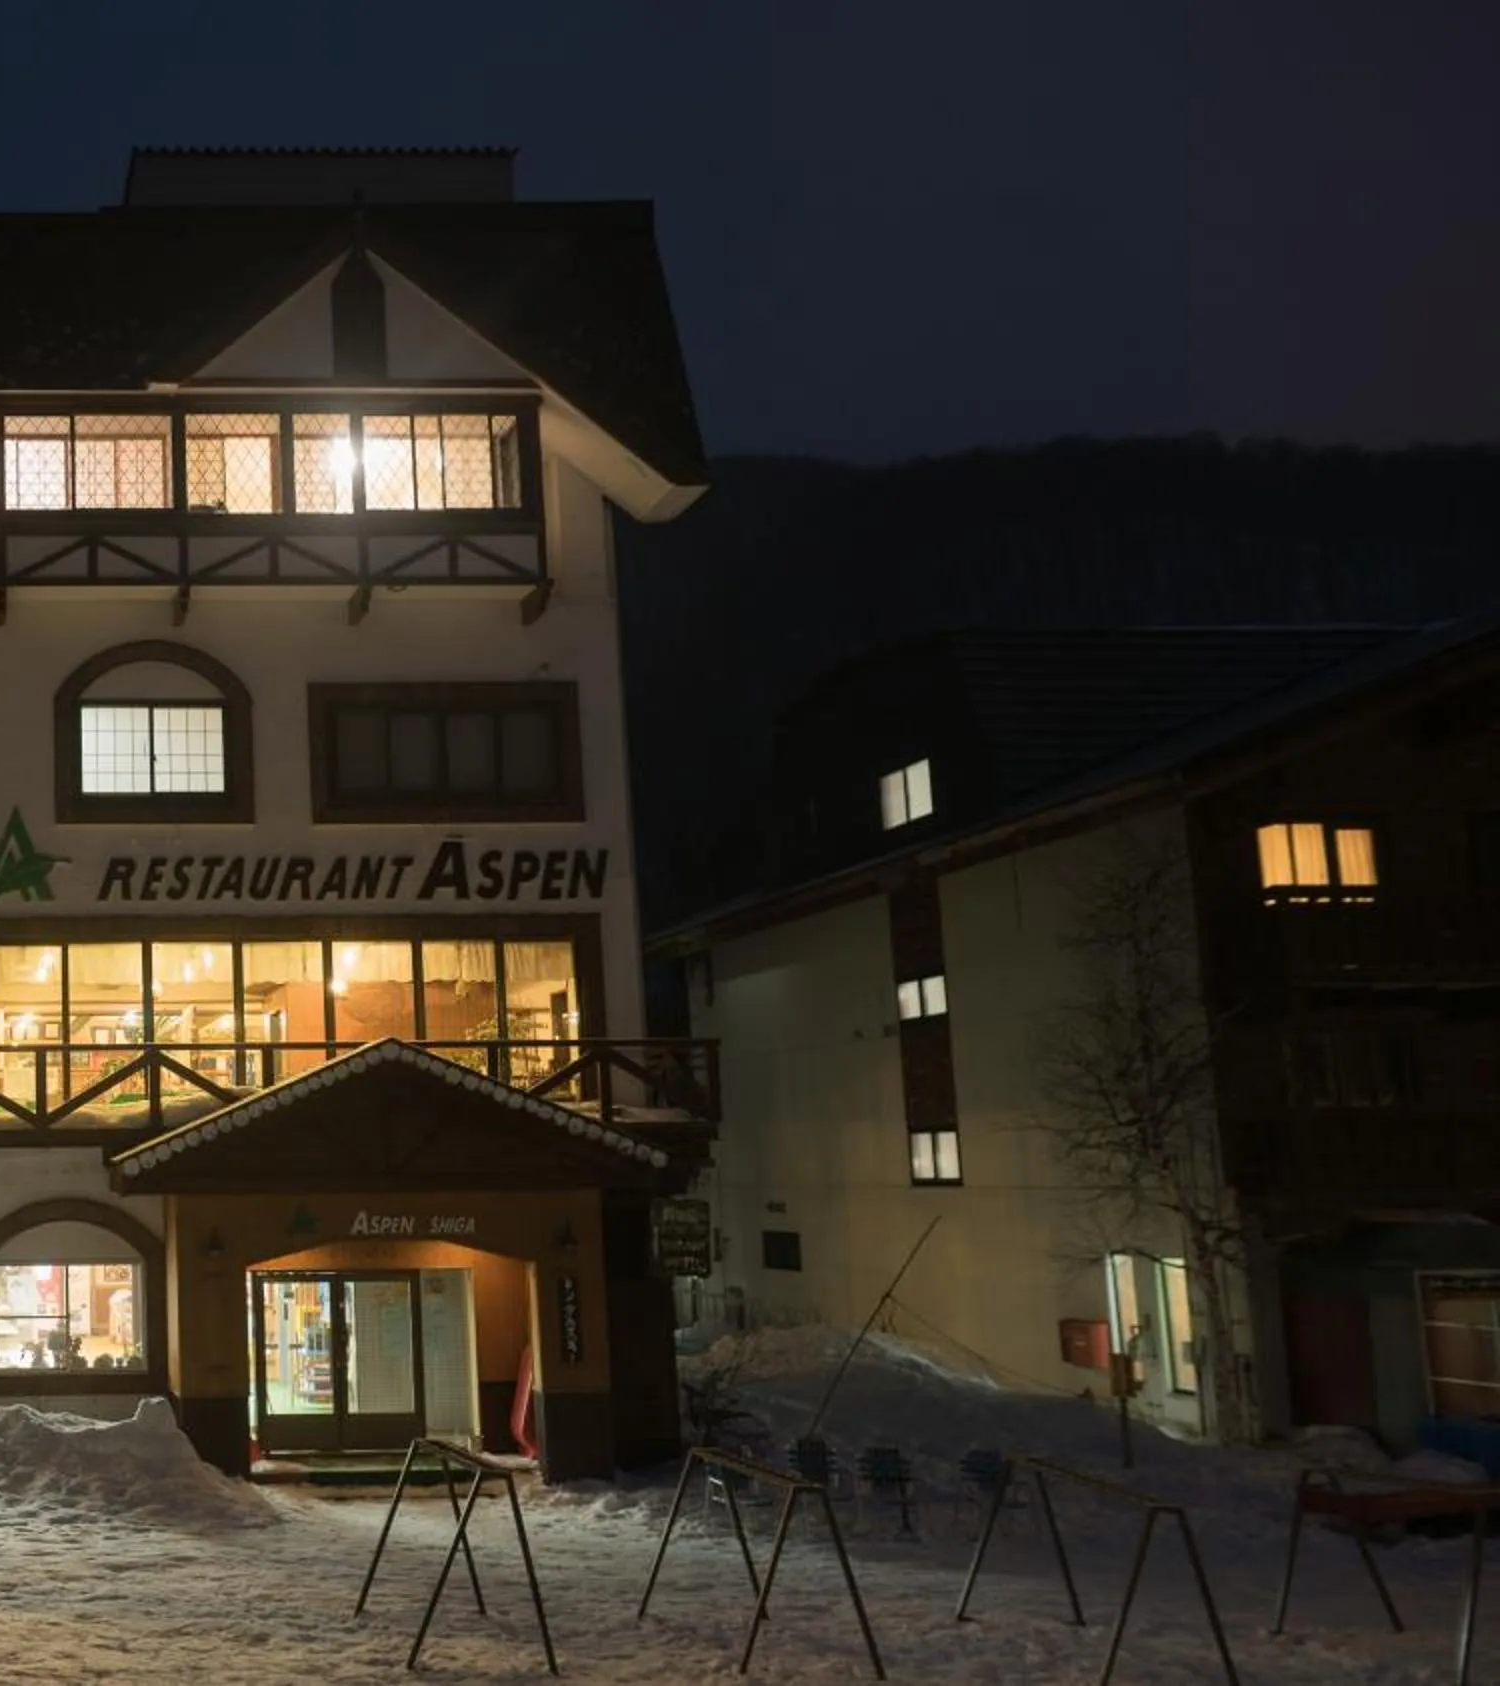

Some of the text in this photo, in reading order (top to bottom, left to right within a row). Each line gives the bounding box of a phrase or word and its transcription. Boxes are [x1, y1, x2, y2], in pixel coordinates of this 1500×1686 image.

[99, 840, 608, 901] RESTAURANT ASPEN
[350, 1209, 476, 1236] ASPEN SHIGA
